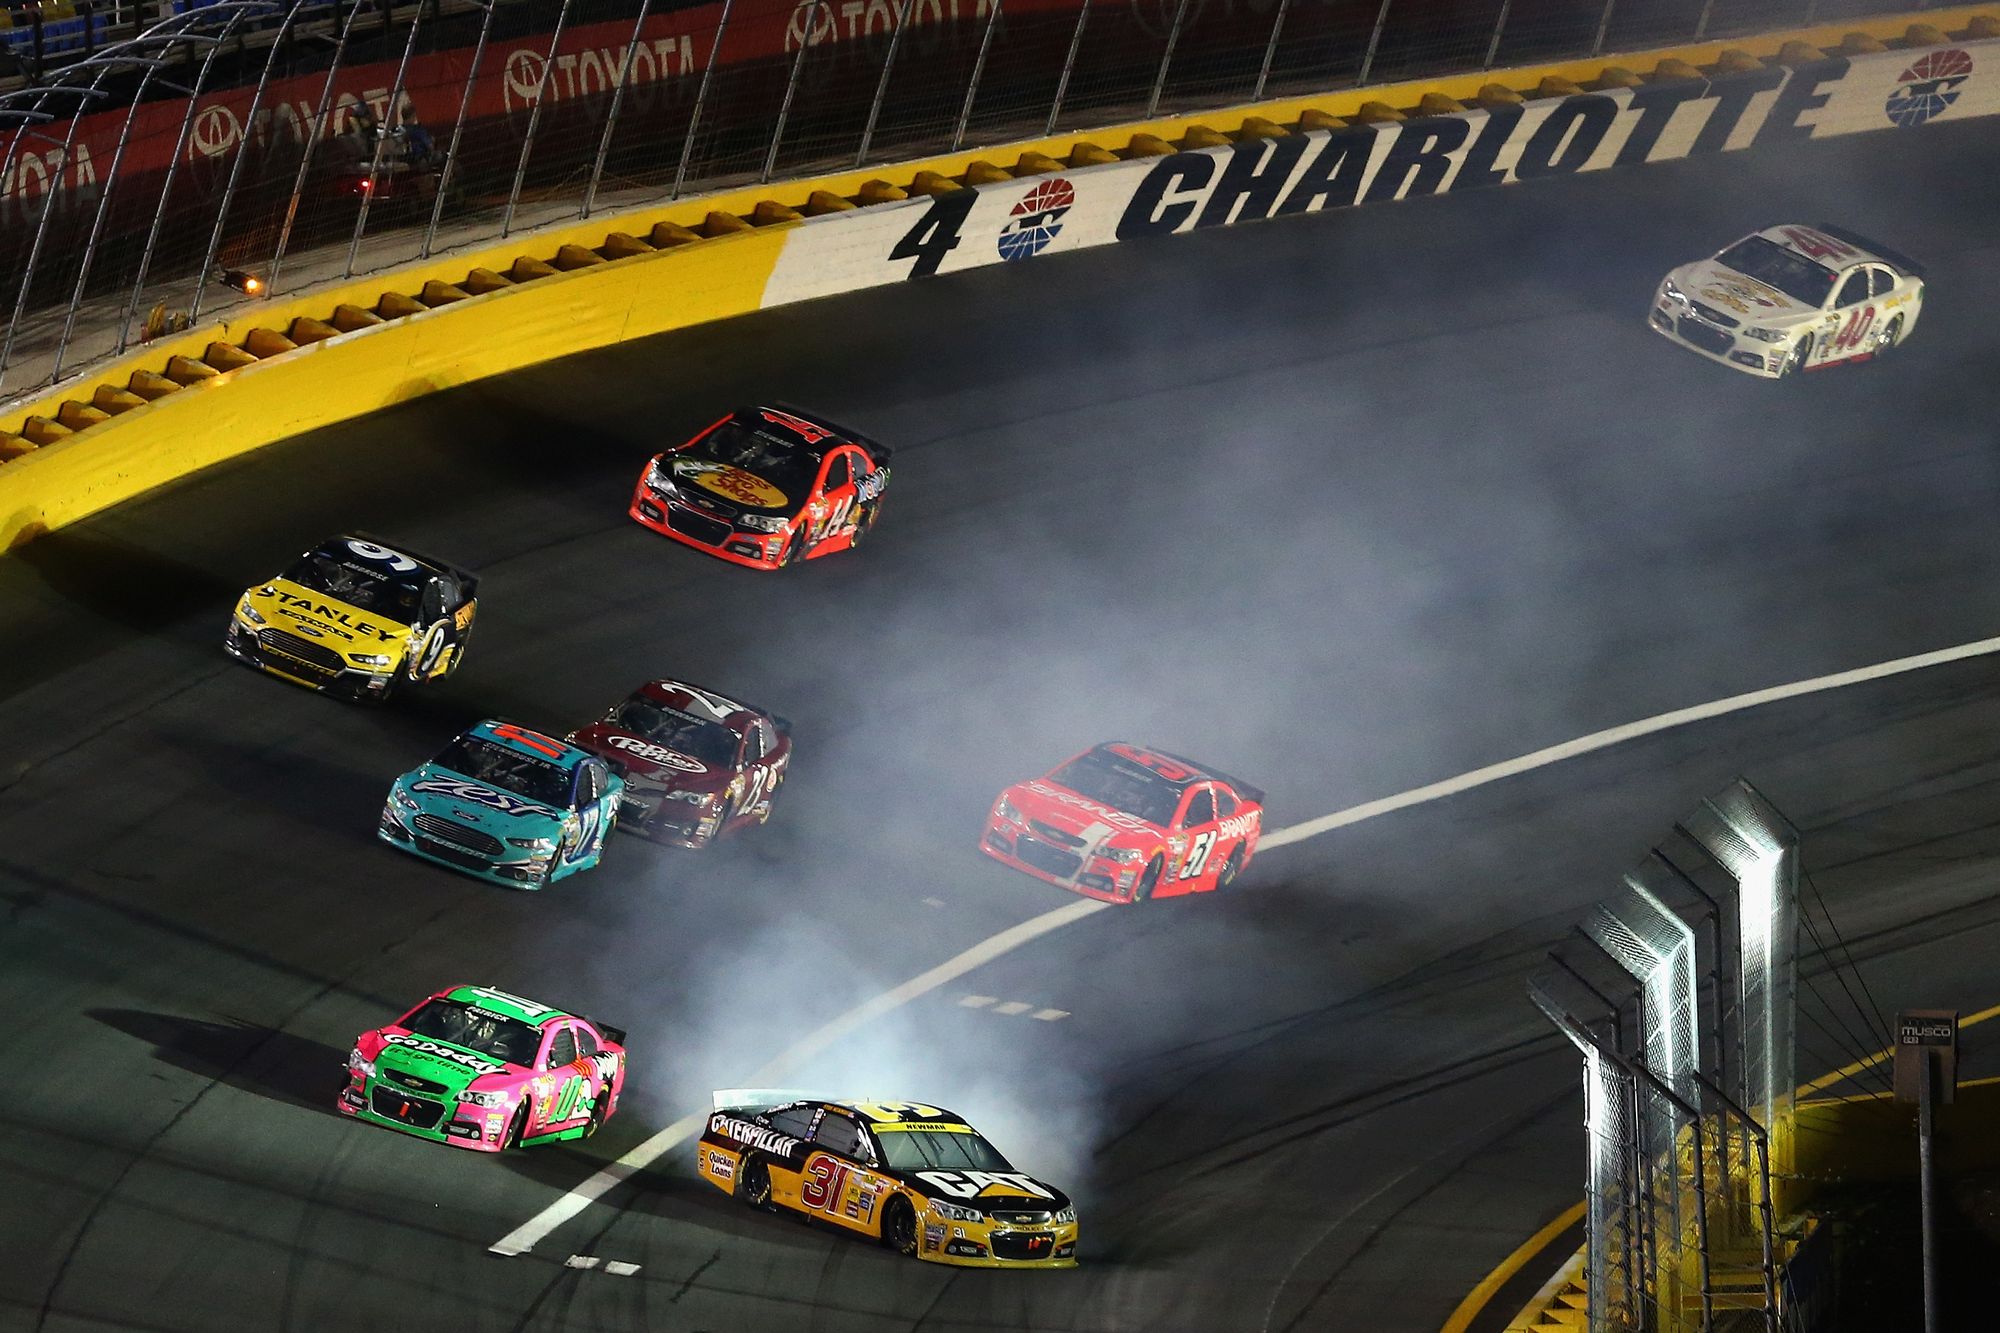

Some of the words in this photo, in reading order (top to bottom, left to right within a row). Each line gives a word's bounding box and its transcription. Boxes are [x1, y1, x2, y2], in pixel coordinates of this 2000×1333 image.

[556, 35, 694, 99] TOYOTA
[1115, 57, 1850, 241] CHARLOTTE
[888, 187, 980, 280] 4
[1832, 305, 1876, 352] 40
[256, 586, 399, 642] STANLEY
[410, 772, 561, 820] Zest
[1179, 829, 1218, 880] 51
[466, 1005, 510, 1023] PATRICK
[383, 1034, 511, 1076] GoDaddy
[546, 1074, 583, 1123] 10
[711, 1114, 800, 1158] CATERPILLAR
[906, 1123, 946, 1131] NEWMAN
[801, 1154, 850, 1216] 31
[915, 1170, 1056, 1200] CAT
[953, 1227, 966, 1239] 31
